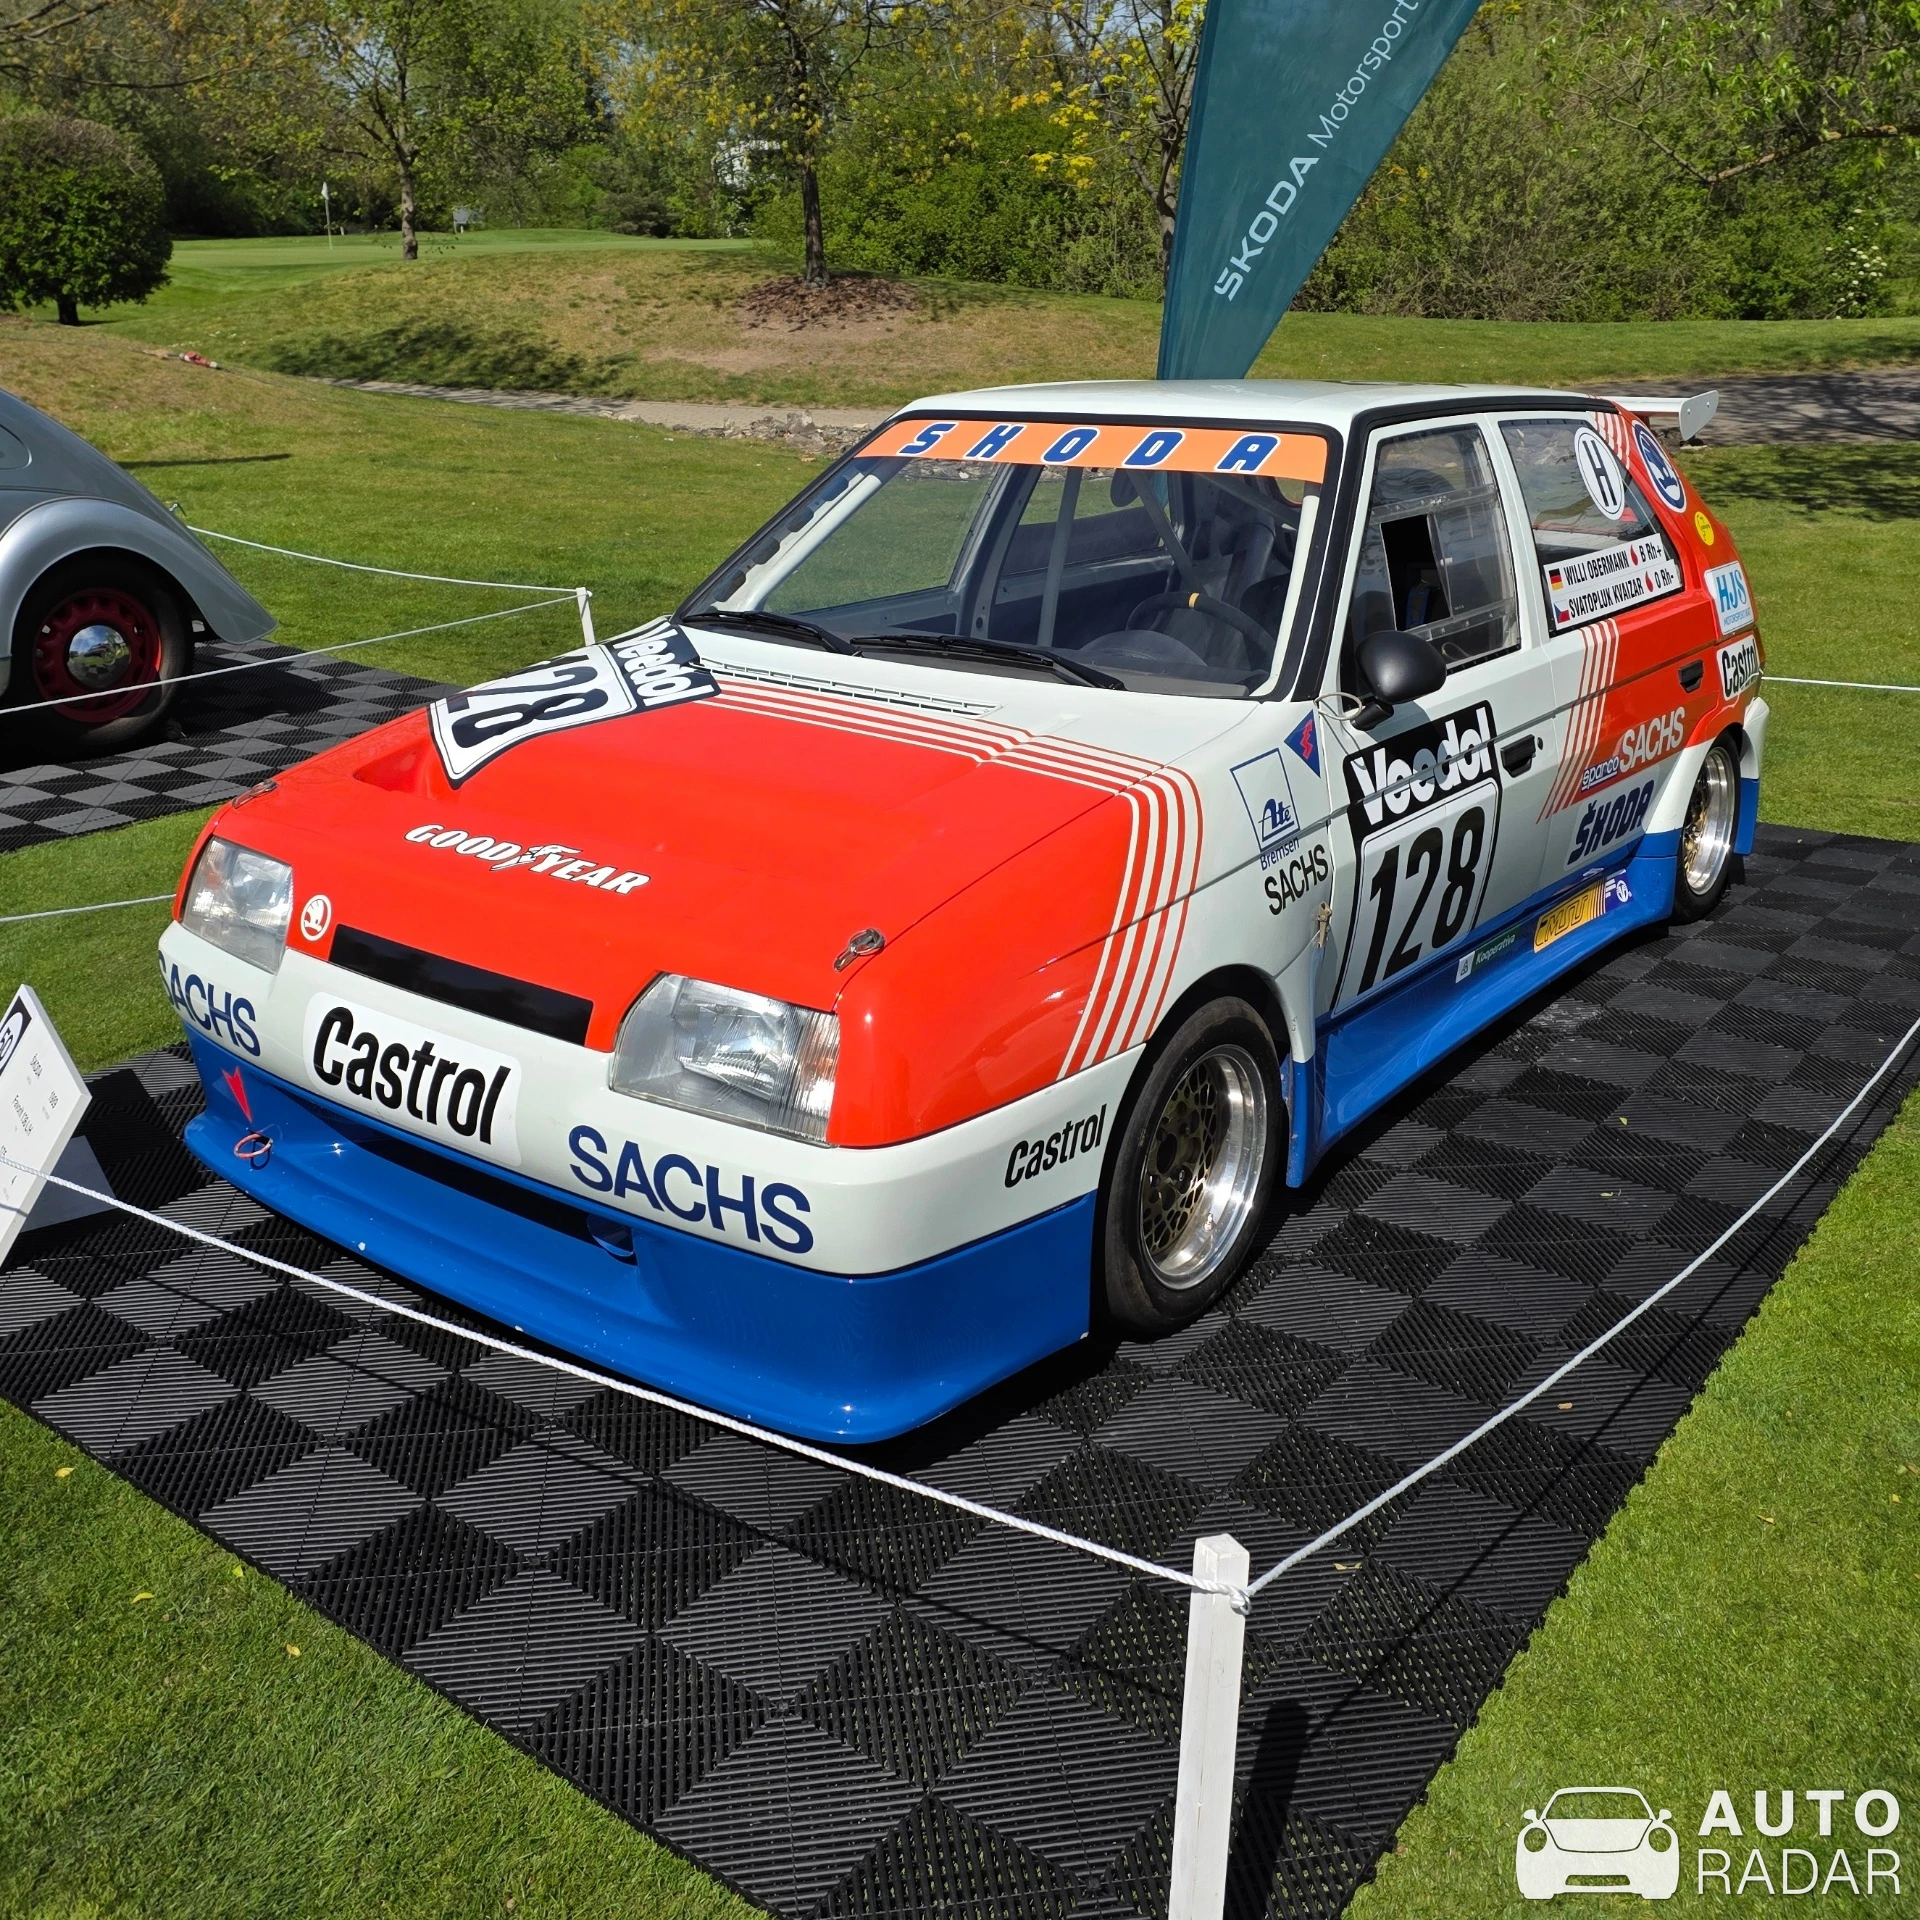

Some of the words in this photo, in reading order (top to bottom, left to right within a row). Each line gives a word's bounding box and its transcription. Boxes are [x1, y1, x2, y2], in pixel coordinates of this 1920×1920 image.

[1307, 0, 1419, 148] Motorsport
[1582, 440, 1617, 507] H
[1564, 562, 1588, 585] WILLI
[1587, 550, 1629, 579] OBERMANN
[1639, 545, 1646, 562] B
[1612, 578, 1644, 603] KVAIZAR
[1716, 569, 1747, 613] HJS
[612, 621, 714, 706] Veedol
[1721, 639, 1759, 698] Castrol
[1350, 706, 1493, 826] Veedol
[1583, 756, 1620, 789] sparco
[1620, 706, 1685, 773] SACHS
[1260, 837, 1300, 871] Bremsen
[1264, 844, 1329, 915] SACHS
[1357, 806, 1485, 996] 128
[313, 1006, 511, 1145] Castrol
[1004, 1103, 1107, 1188] Castrol
[569, 1125, 814, 1254] SACHS
